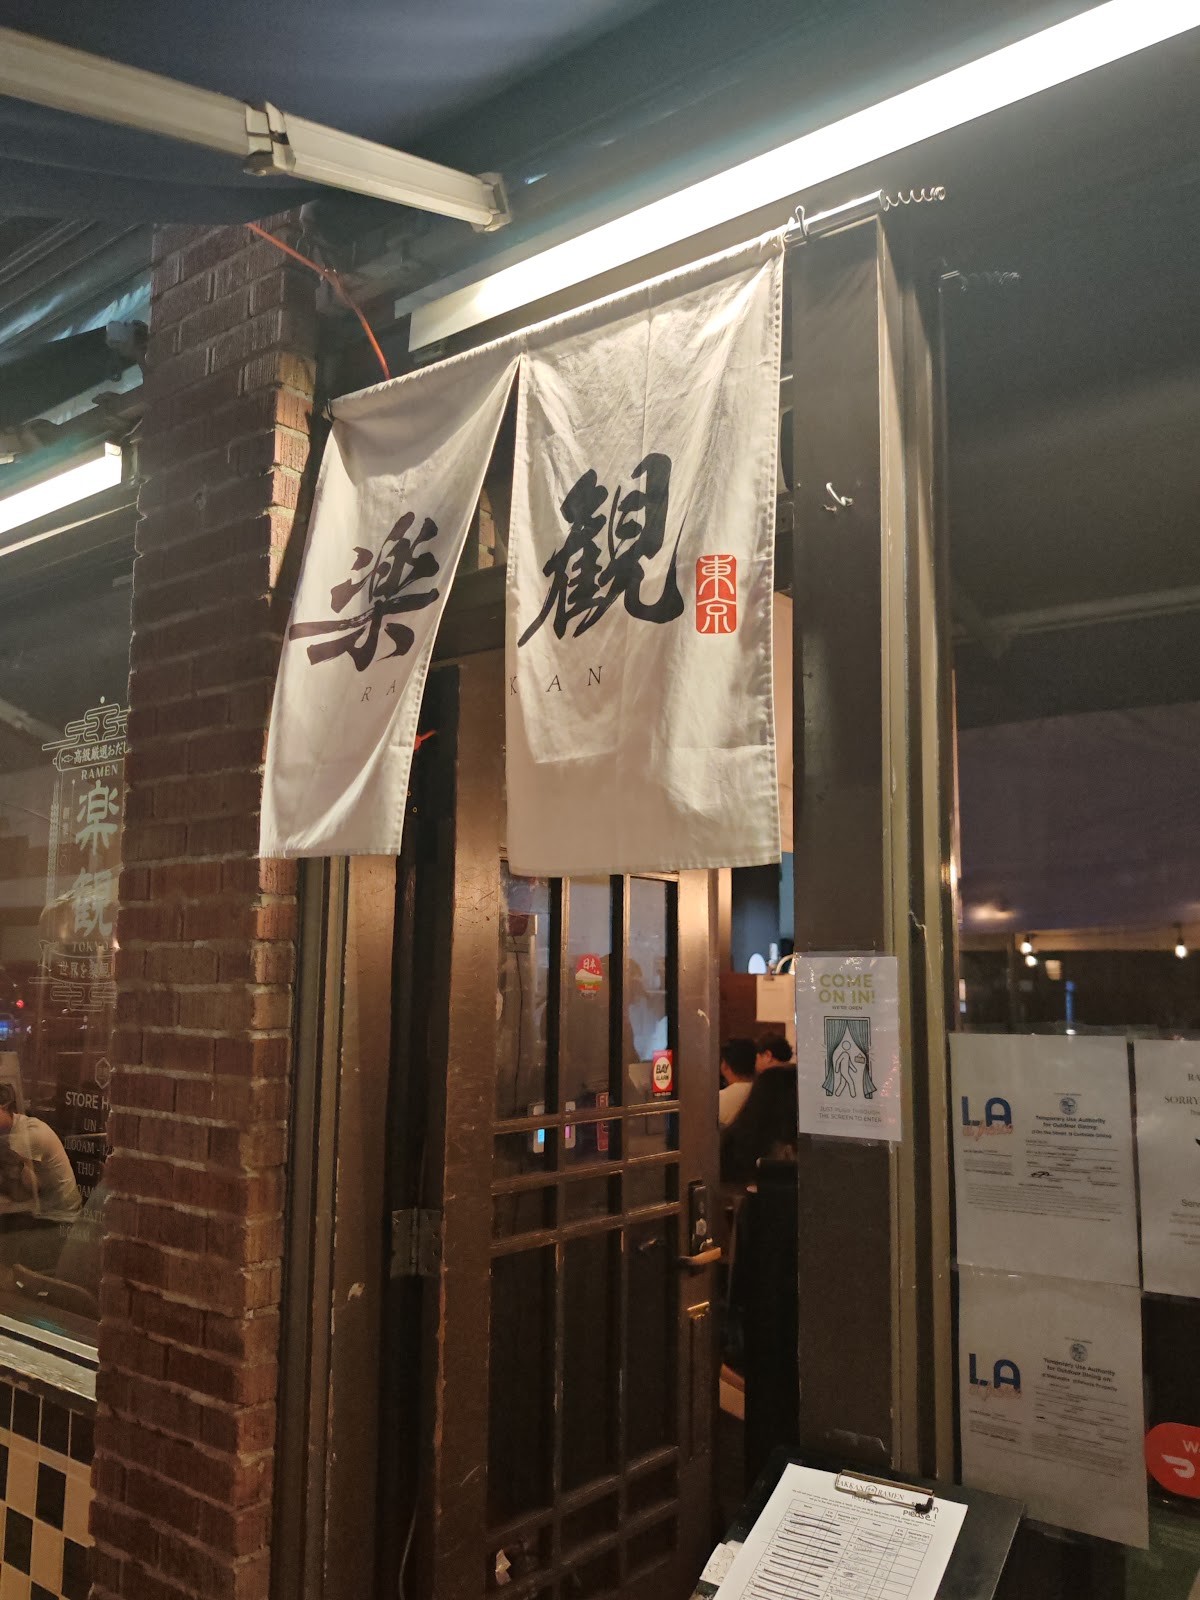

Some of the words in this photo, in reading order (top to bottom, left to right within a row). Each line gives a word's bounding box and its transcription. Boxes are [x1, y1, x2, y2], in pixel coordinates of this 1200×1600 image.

[697, 555, 737, 634] 東京
[81, 763, 119, 780] RAMEN
[819, 973, 873, 988] COME
[818, 989, 845, 1003] ON
[851, 989, 876, 1005] IN!
[656, 1063, 670, 1074] BAY
[65, 1091, 99, 1110] STORE
[831, 1113, 854, 1121] SCREEN
[961, 1095, 1012, 1127] LA
[76, 1161, 95, 1177] THU
[968, 1352, 1021, 1394] LA
[1087, 1366, 1116, 1377] Authority
[1182, 1439, 1200, 1454] W
[877, 1488, 905, 1502] RAMEN
